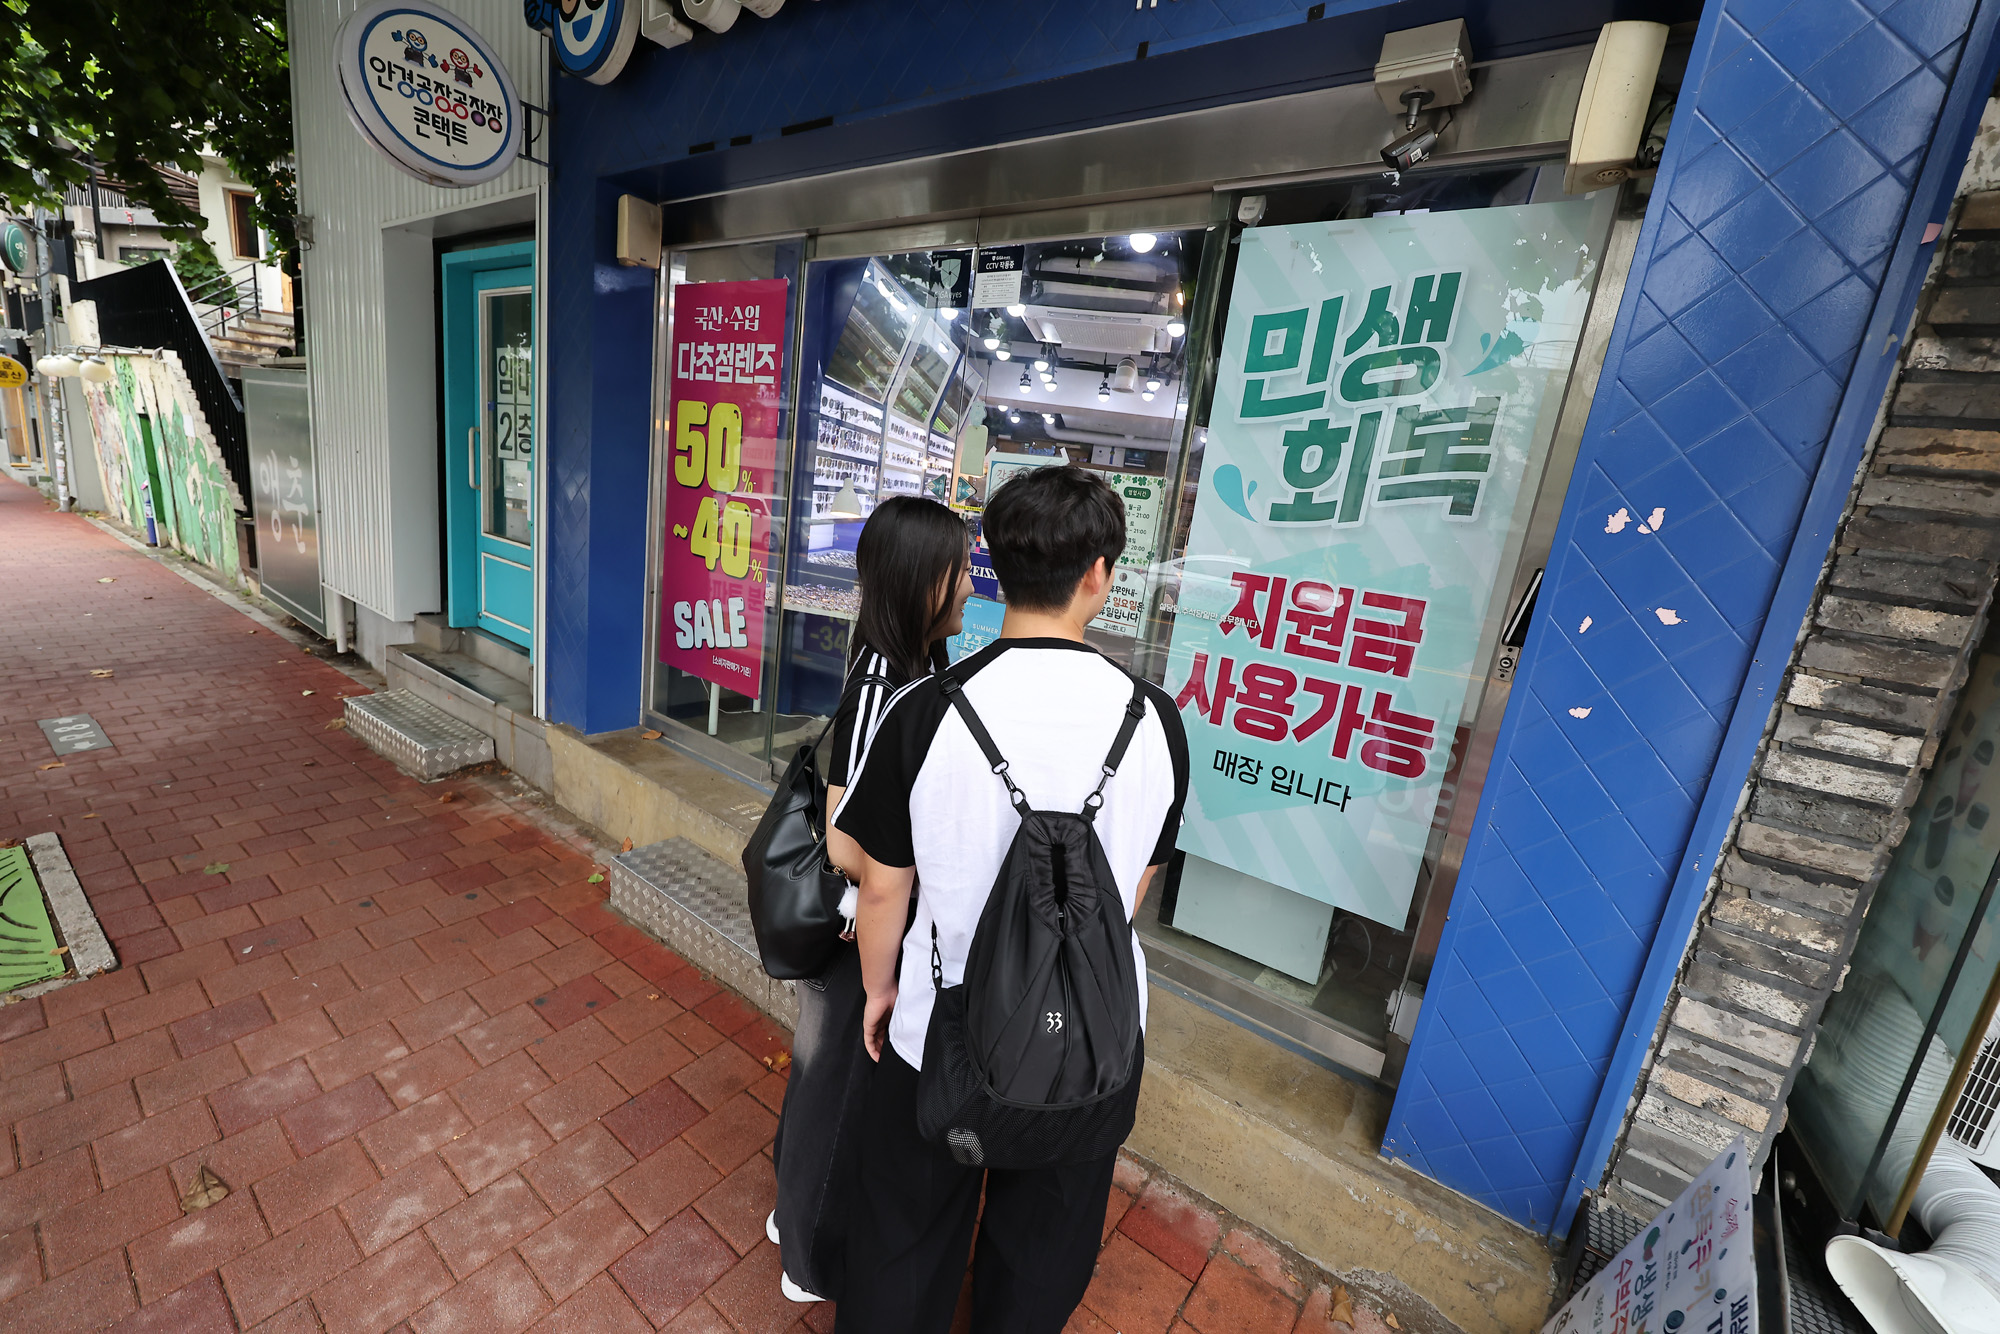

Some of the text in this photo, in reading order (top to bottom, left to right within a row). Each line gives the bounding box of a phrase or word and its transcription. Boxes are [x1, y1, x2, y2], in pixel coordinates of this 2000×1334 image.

[369, 56, 503, 133] 안경공장공장장
[413, 107, 468, 147] 콘택트
[677, 341, 777, 384] 다초점렌즈
[1238, 270, 1462, 421] 민생
[1268, 394, 1500, 525] 회복
[673, 597, 748, 651] SALE
[972, 623, 999, 634] SUMMER
[1113, 596, 1145, 613] 일요일은
[1218, 571, 1425, 679] 지원금
[1177, 650, 1437, 781] 사용가능
[1213, 748, 1352, 814] 매장 입니다
